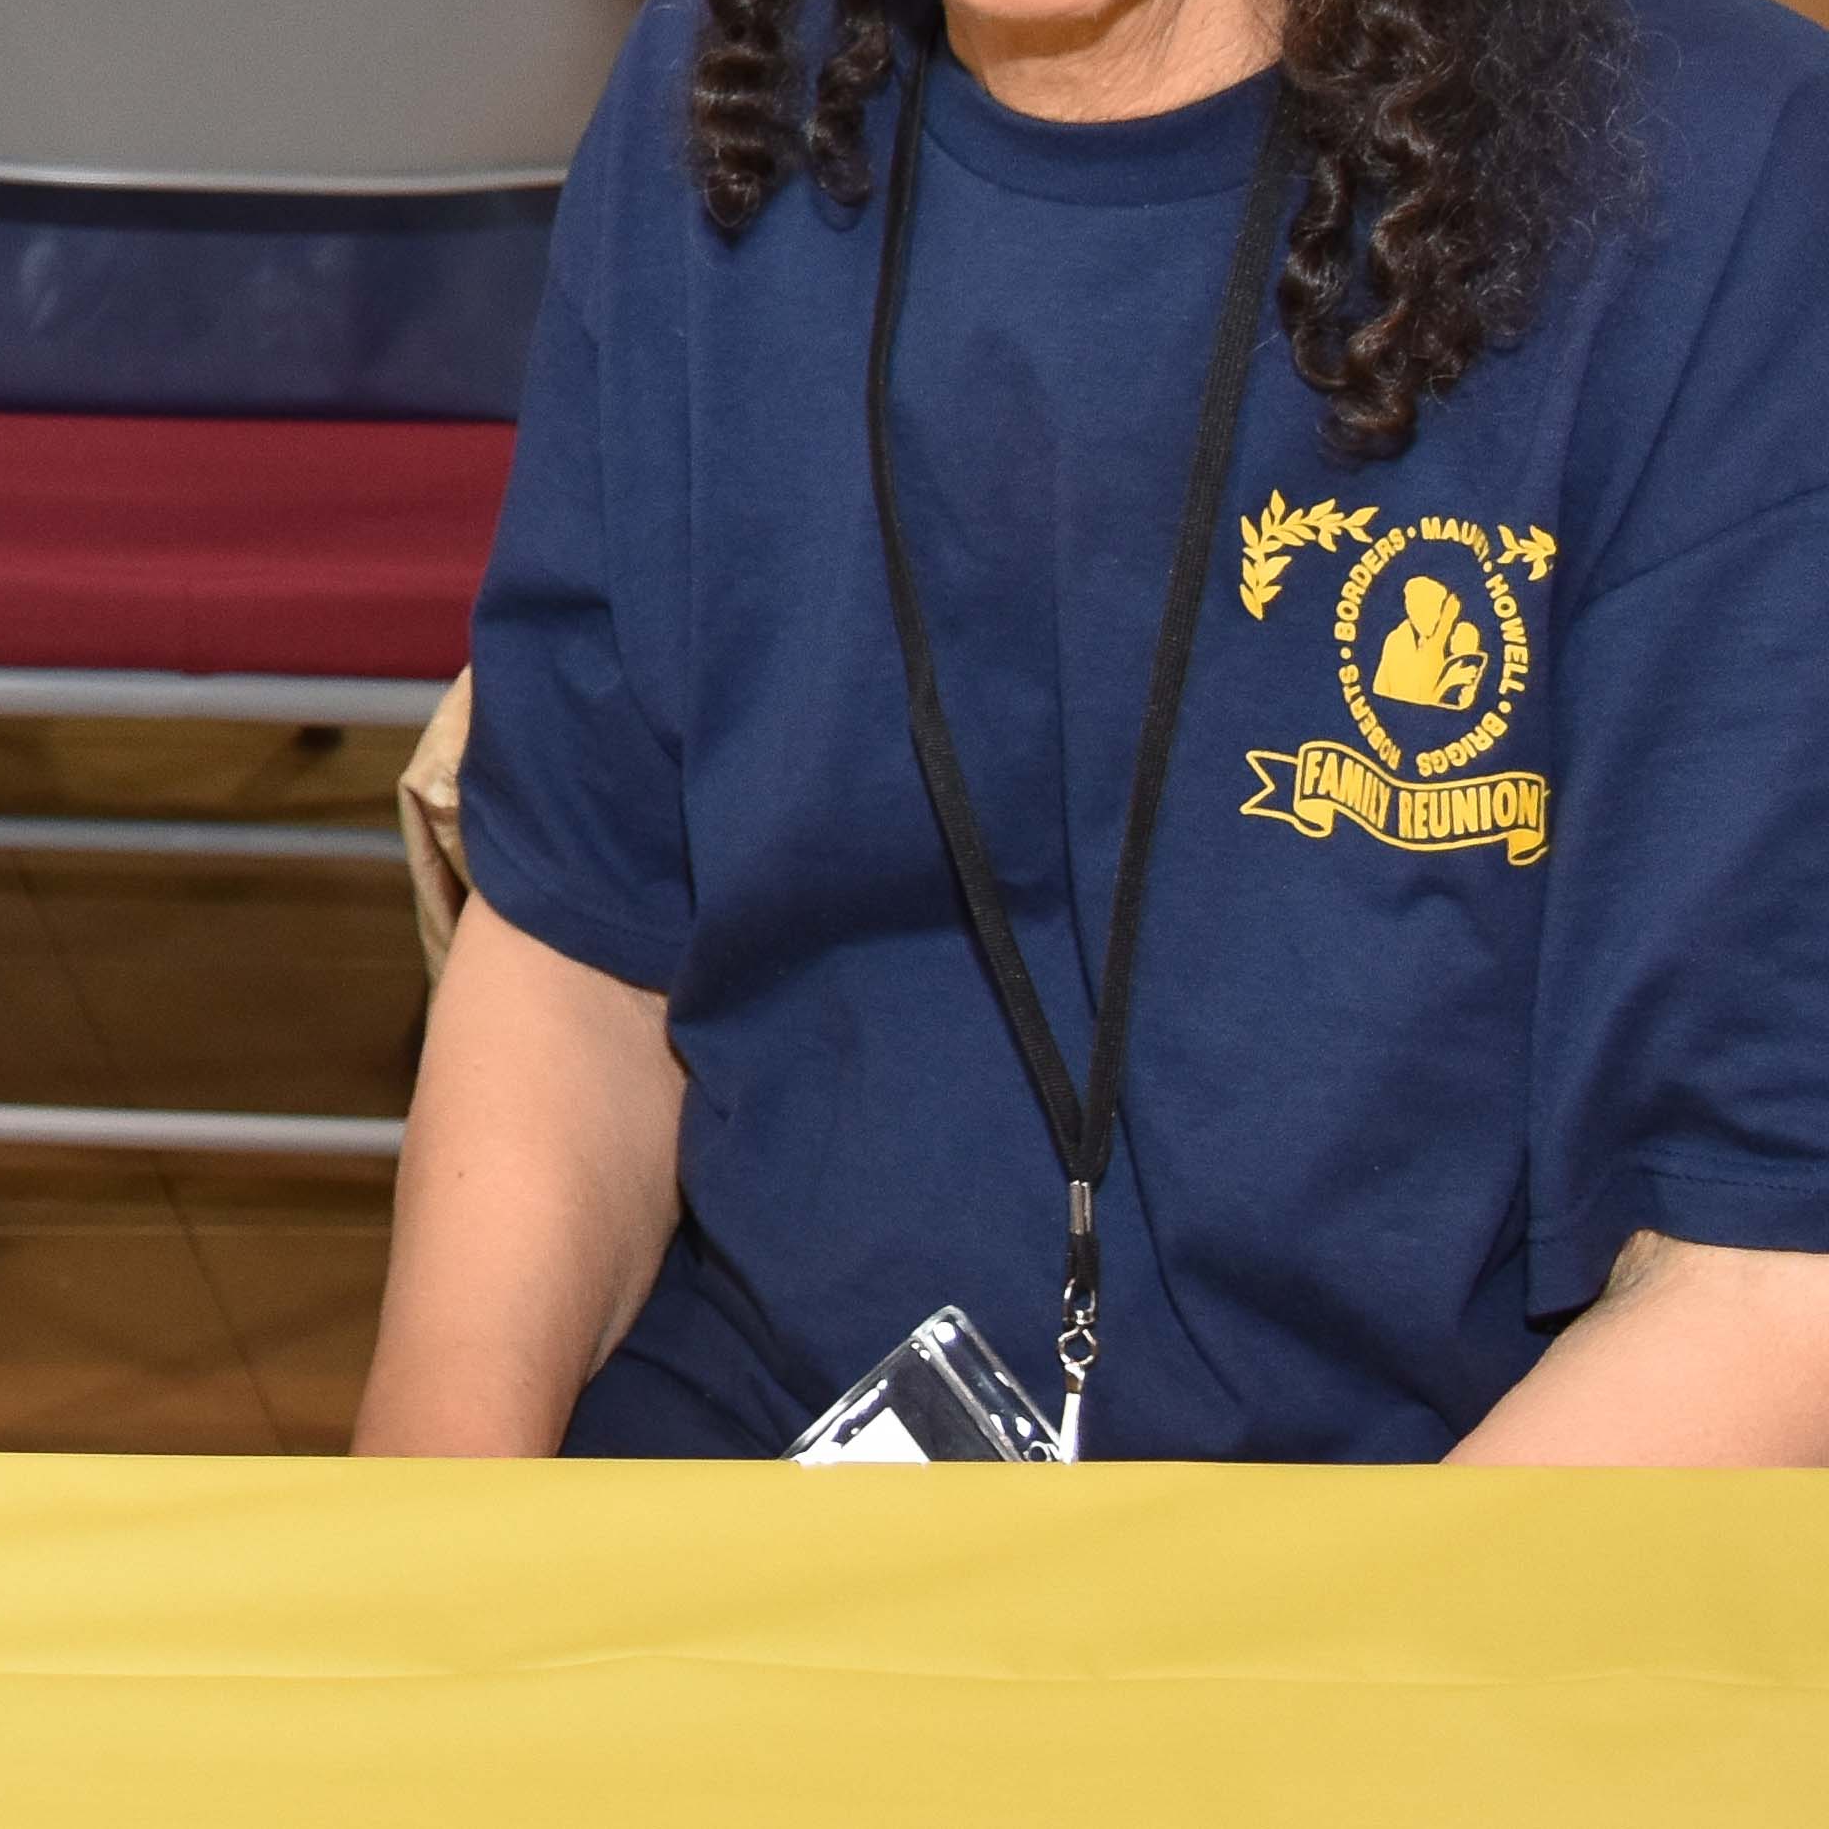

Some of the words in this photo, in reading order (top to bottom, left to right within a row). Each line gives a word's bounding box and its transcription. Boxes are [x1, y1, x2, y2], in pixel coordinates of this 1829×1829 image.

[1334, 527, 1406, 642] BORDERS
[1485, 573, 1529, 693] HOWELL
[1303, 751, 1391, 830] FAMILY
[1398, 780, 1540, 839] REUNION
[1416, 712, 1509, 777] BRIGGS
